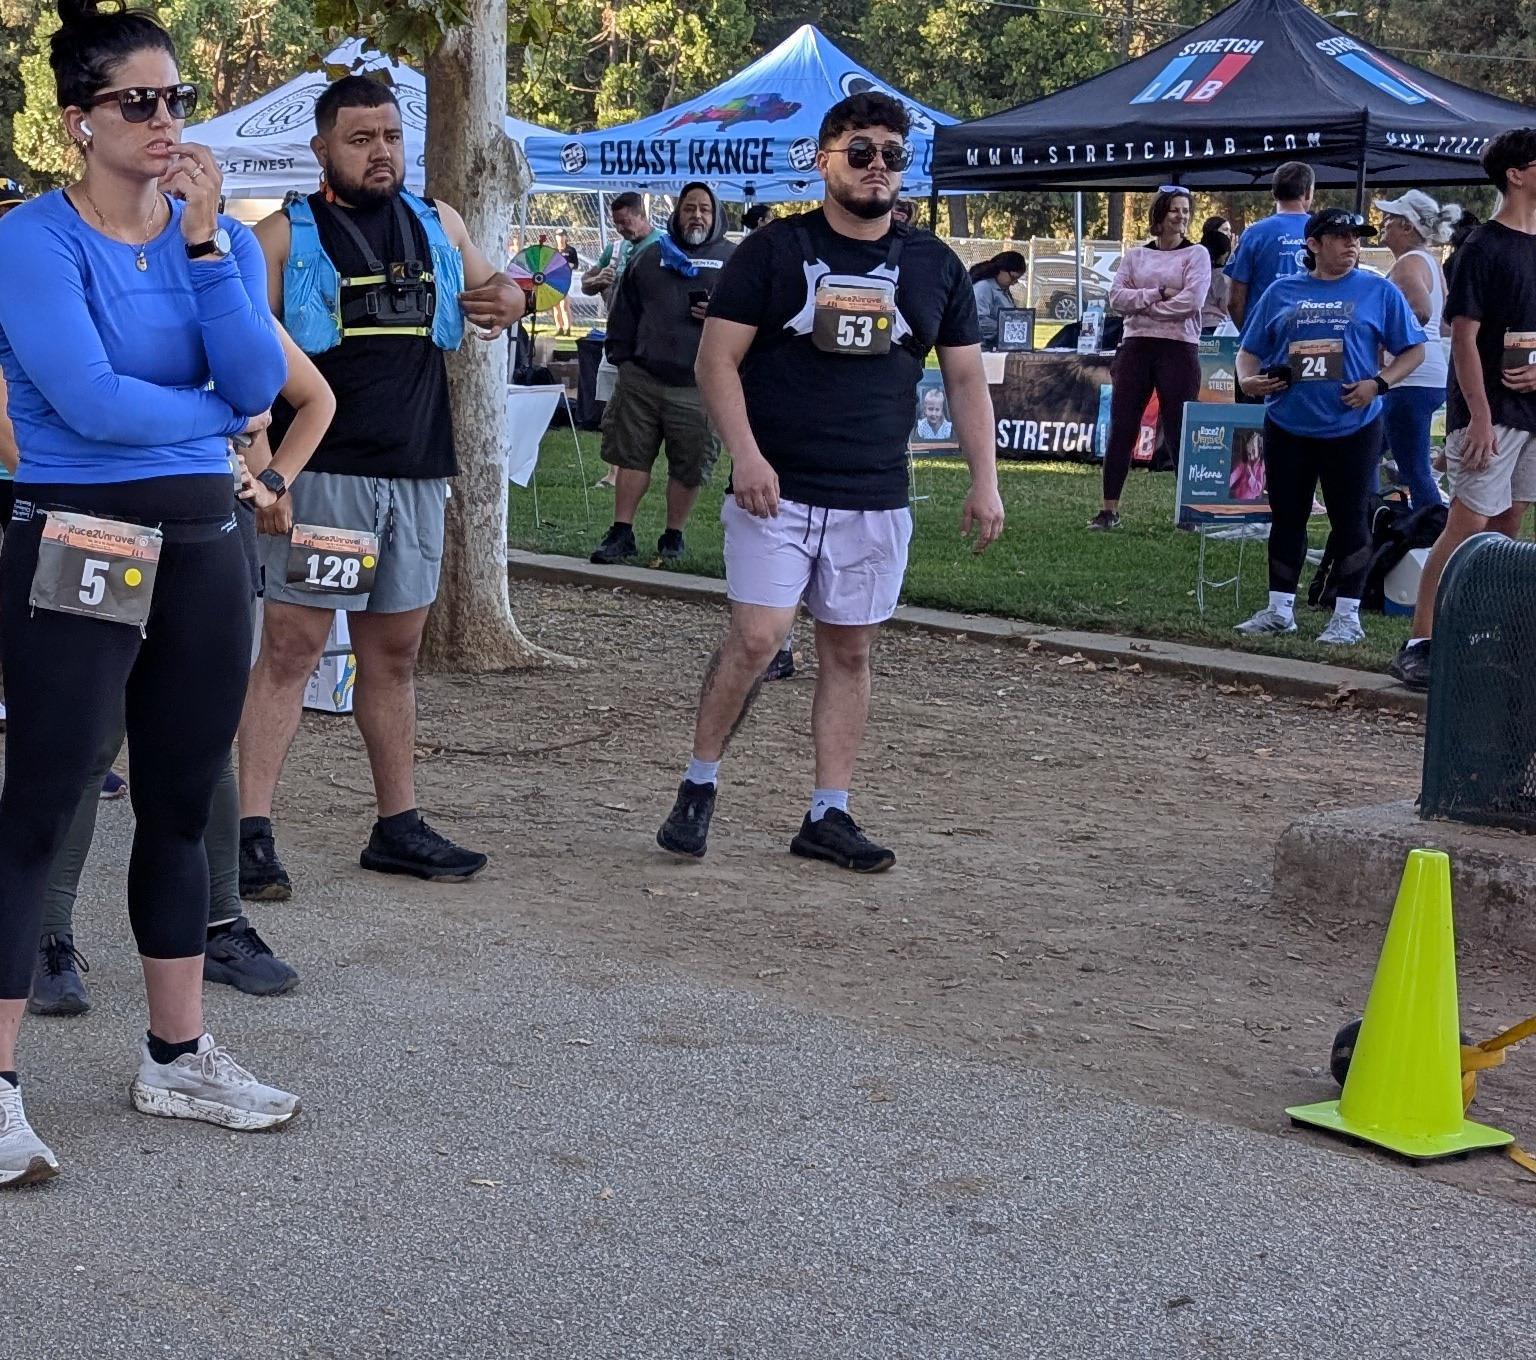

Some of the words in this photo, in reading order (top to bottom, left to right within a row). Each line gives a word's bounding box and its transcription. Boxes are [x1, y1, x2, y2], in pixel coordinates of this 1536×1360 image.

[1179, 38, 1264, 56] STRETCH
[1137, 80, 1224, 101] LAB
[600, 139, 681, 175] COAST
[689, 137, 776, 175] RANGE
[967, 132, 1320, 165] WWW.STRETCHLAB.COM
[243, 157, 295, 173] FINEST
[1301, 301, 1343, 309] Race2
[836, 315, 873, 347] 53
[1301, 356, 1327, 378] 24
[997, 419, 1094, 453] STRETCH
[68, 524, 136, 545] Race2Unravel
[311, 532, 361, 545] Race2Unravel
[79, 558, 109, 605] 5
[304, 554, 360, 589] 128
